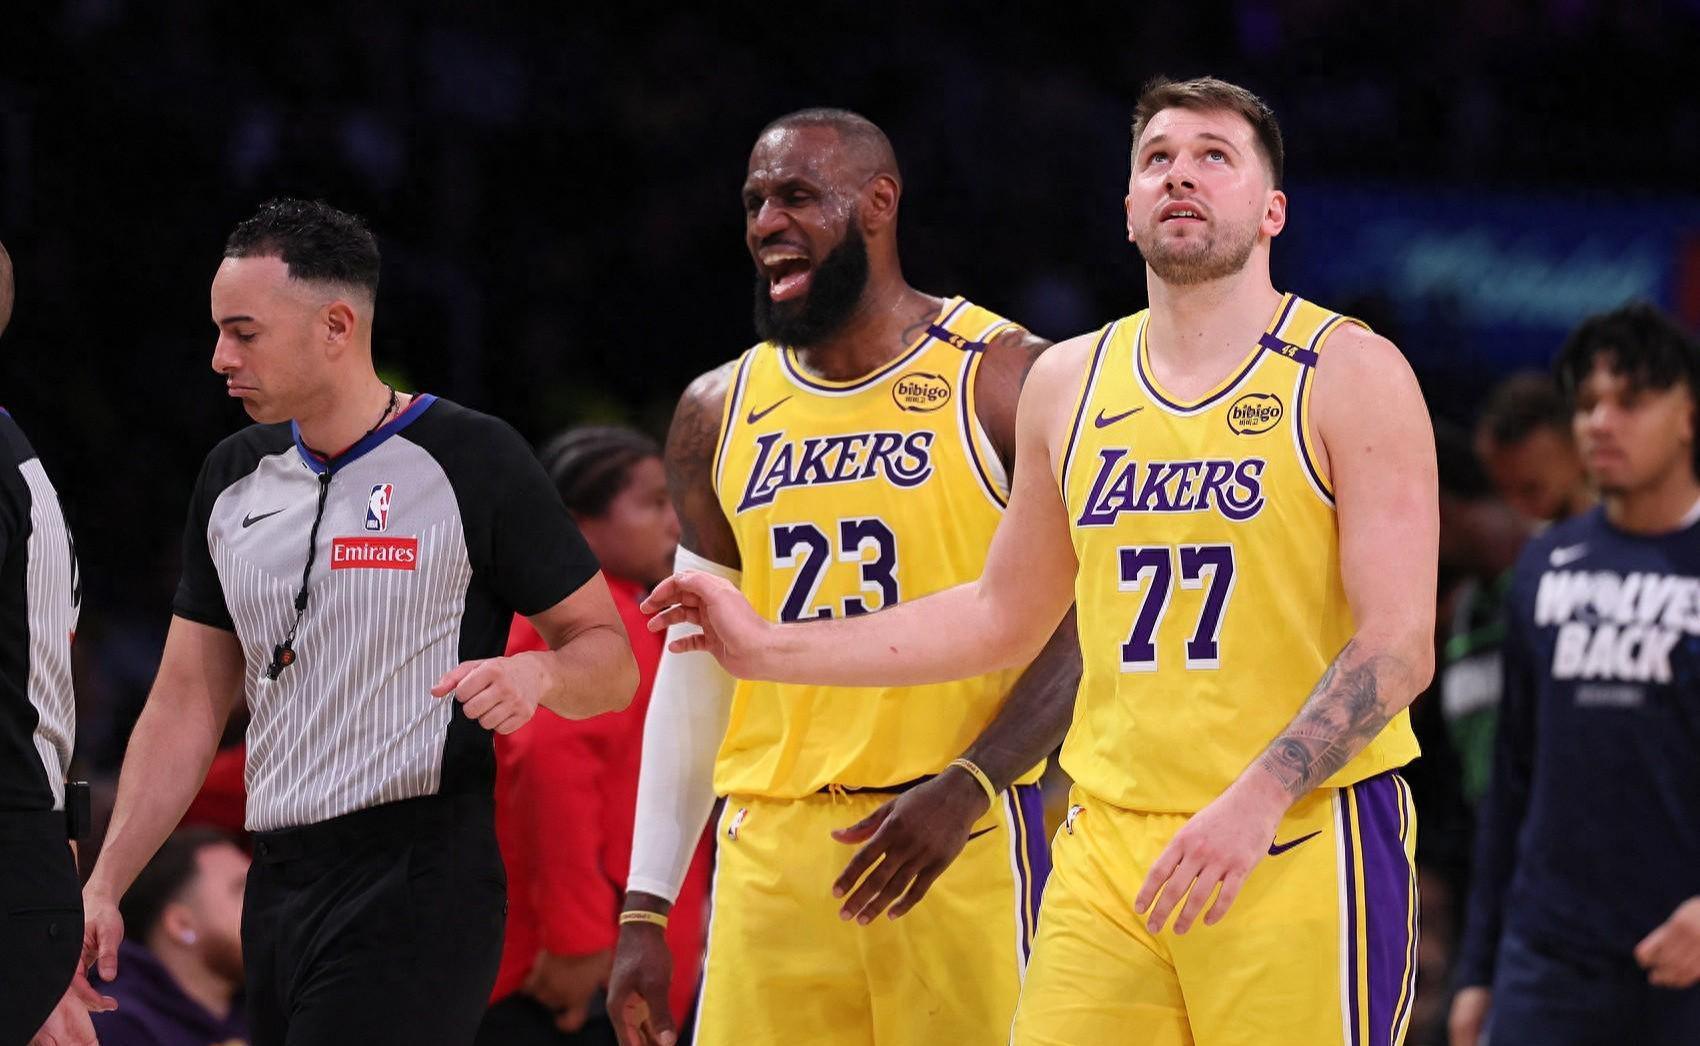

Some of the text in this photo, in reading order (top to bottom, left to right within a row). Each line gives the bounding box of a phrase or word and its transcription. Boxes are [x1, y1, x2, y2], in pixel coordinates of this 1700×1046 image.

[898, 382, 948, 402] bibigo
[1232, 403, 1280, 422] bibigo
[738, 431, 934, 514] LAKERS
[1076, 448, 1266, 527] LAKERS
[334, 543, 415, 562] Emirates
[772, 517, 900, 624] 23
[1117, 544, 1236, 672] 77
[1534, 570, 1700, 636] WOLVE
[1552, 621, 1682, 684] BACK
